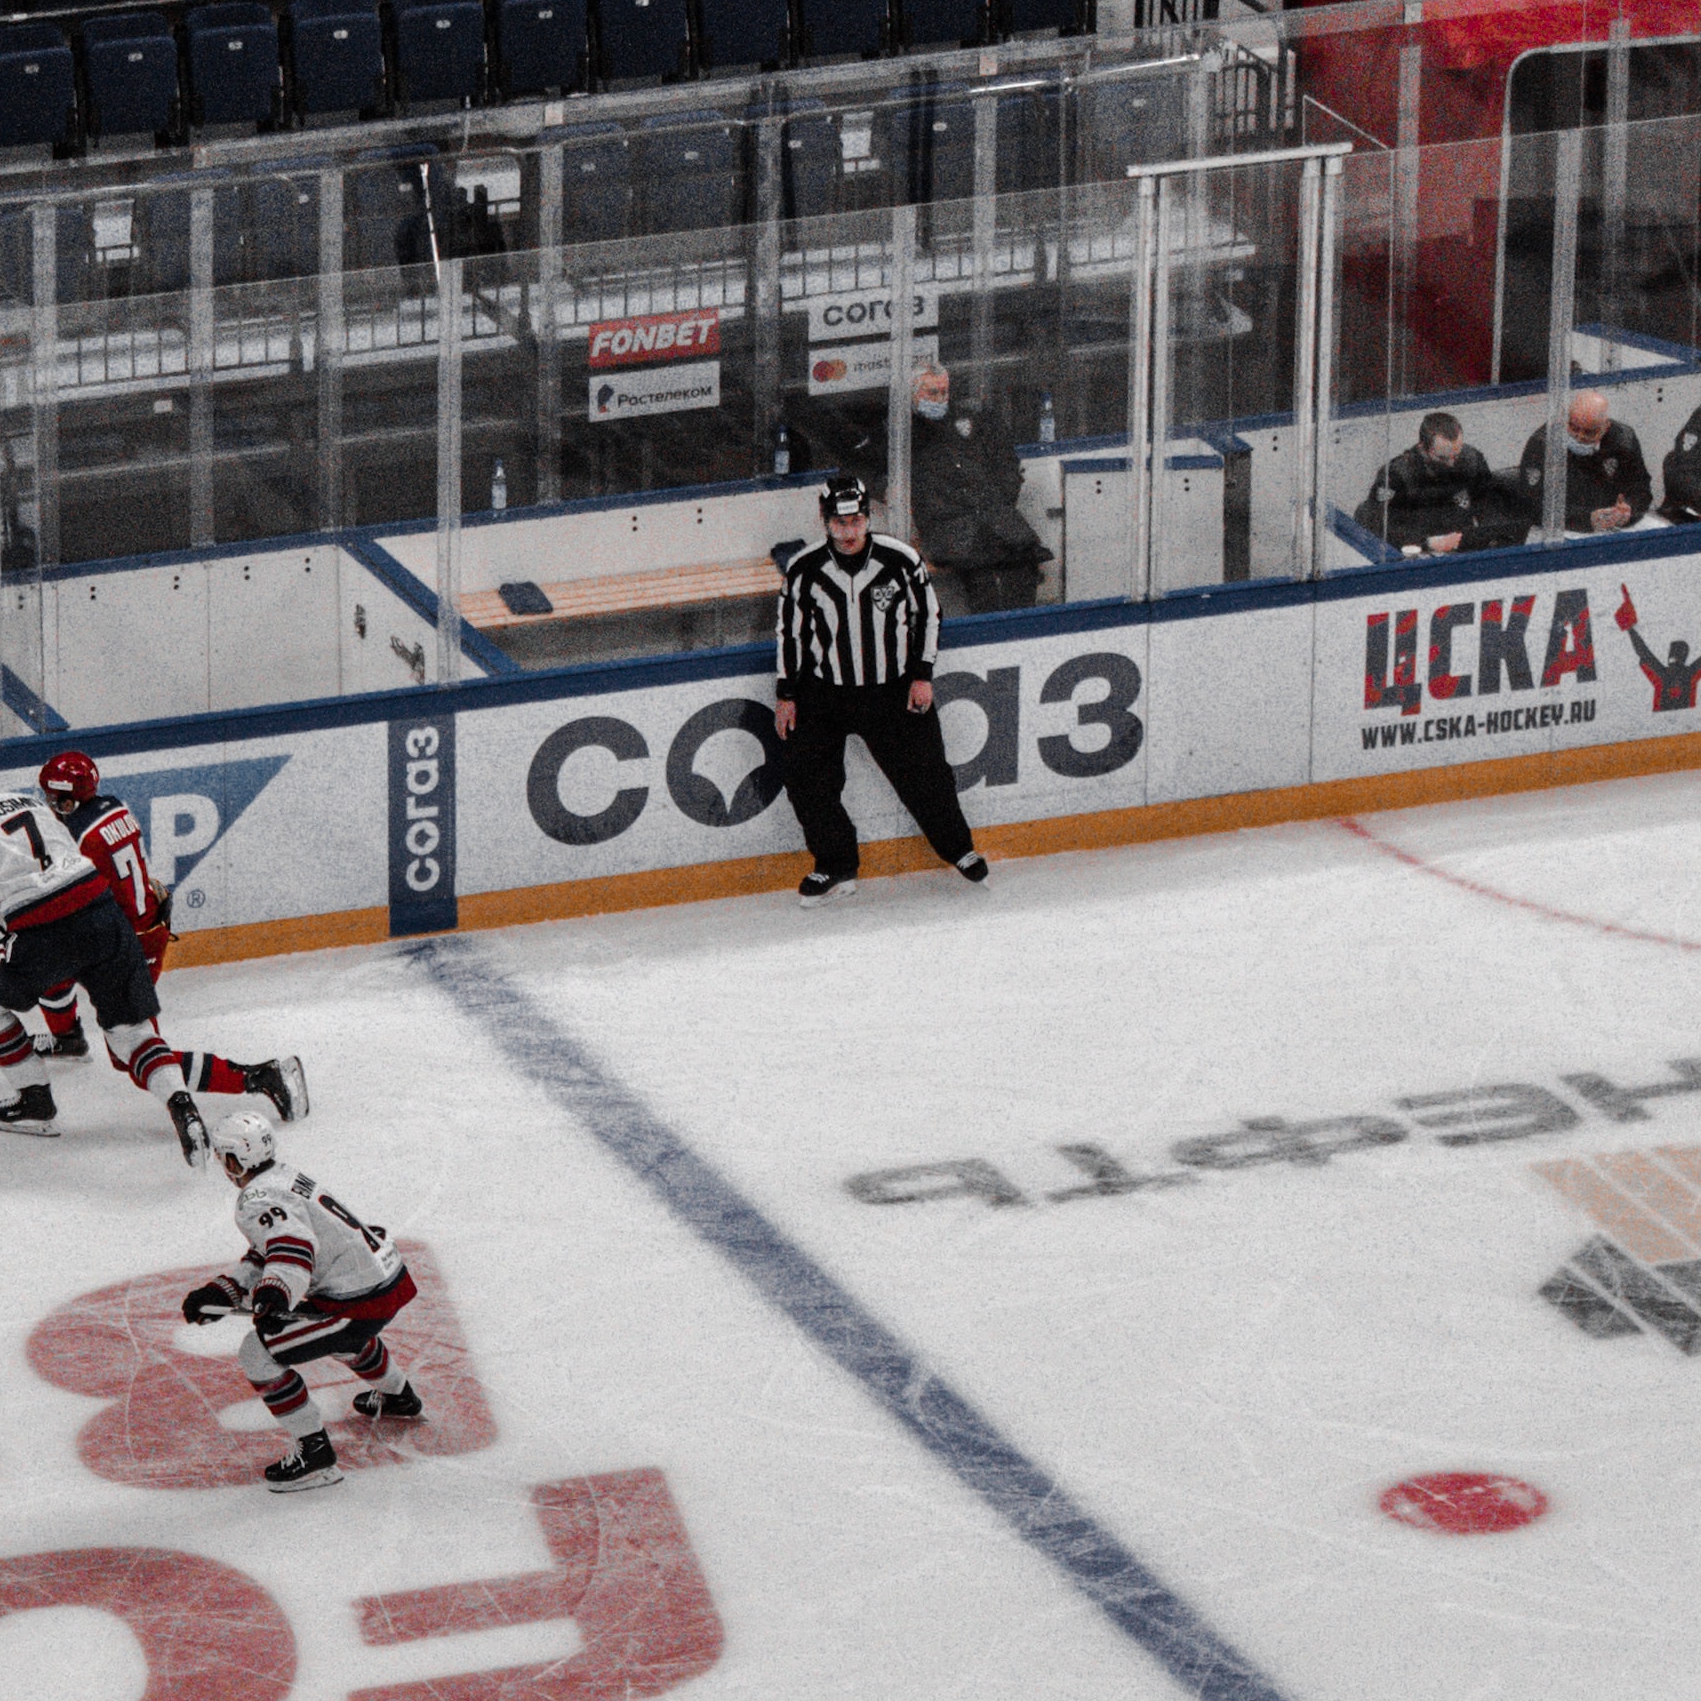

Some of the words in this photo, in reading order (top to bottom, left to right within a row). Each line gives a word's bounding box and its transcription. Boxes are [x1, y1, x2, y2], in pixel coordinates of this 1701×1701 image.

[591, 317, 718, 358] FONBET
[617, 384, 714, 410] Ростелеком
[1364, 588, 1598, 716] ЦСКА
[526, 652, 1144, 846] соаз
[1361, 699, 1597, 750] WWW.CSKA-HOCKEY.RU
[0, 810, 53, 873] 7
[258, 1206, 288, 1229] 99
